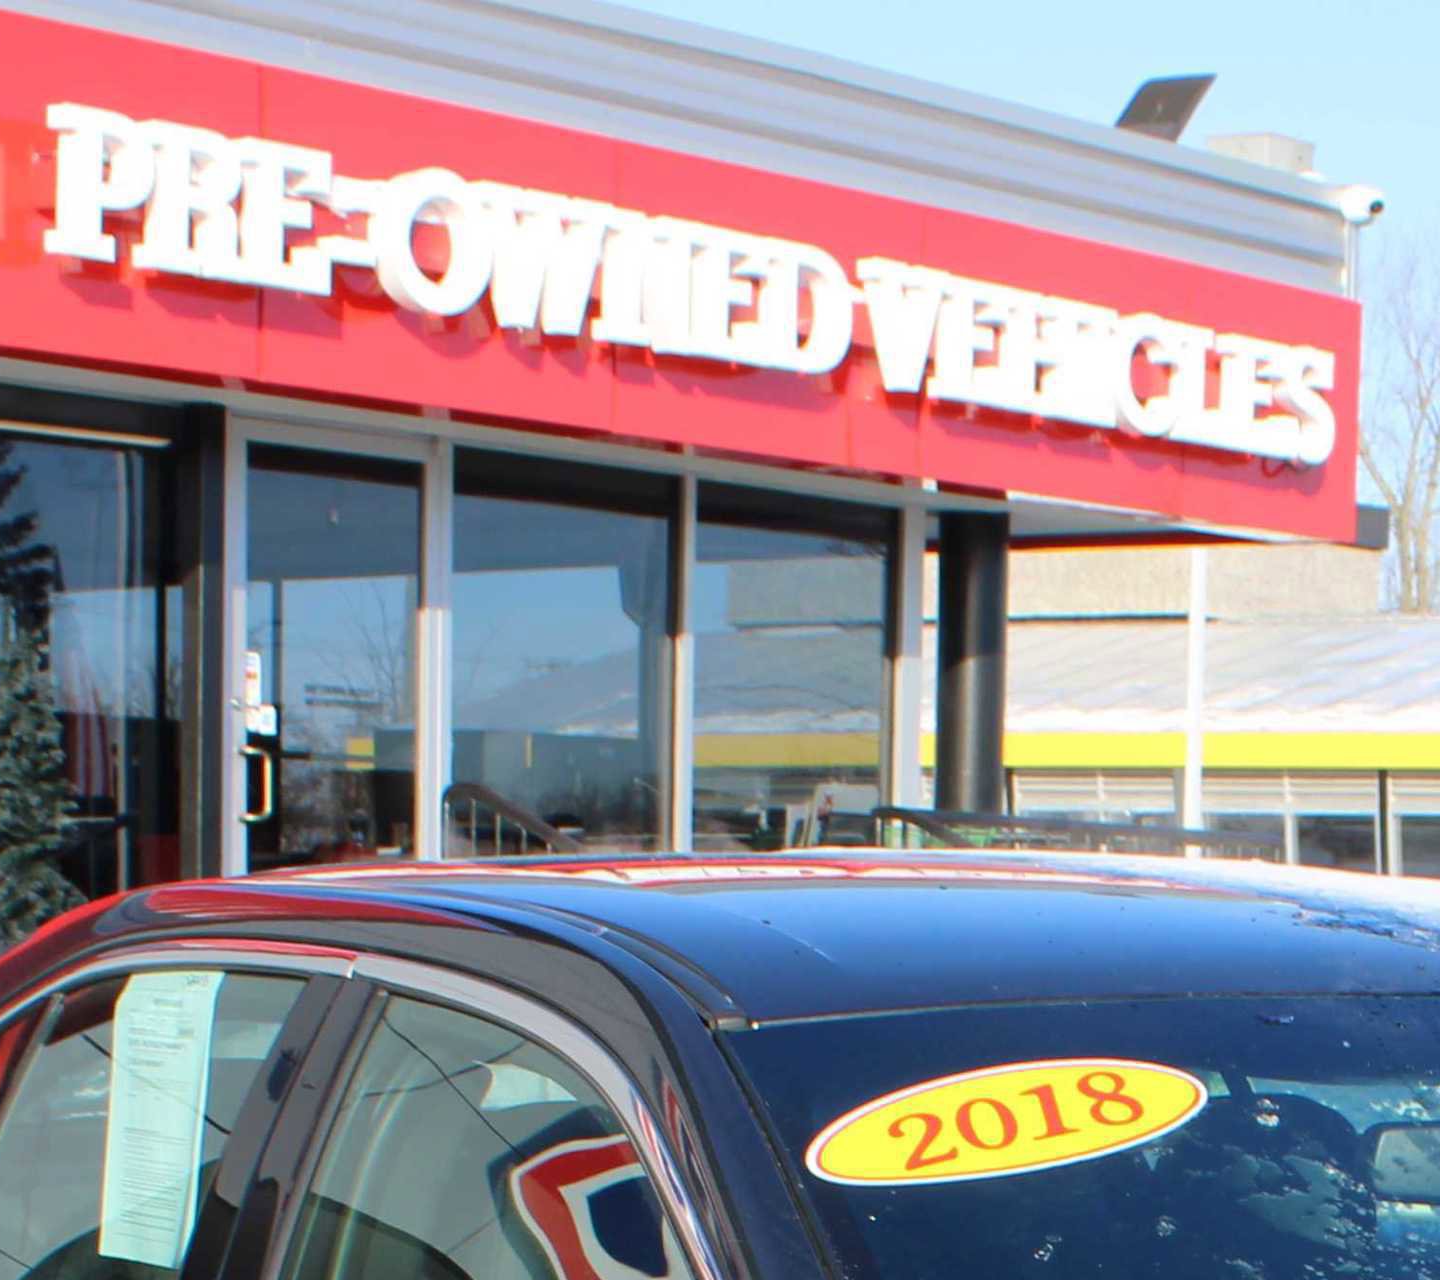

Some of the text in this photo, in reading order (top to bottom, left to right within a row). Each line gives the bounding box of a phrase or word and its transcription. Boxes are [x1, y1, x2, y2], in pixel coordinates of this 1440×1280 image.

[43, 101, 1337, 466] PRE-OWNED VEHICLES
[887, 1070, 1145, 1172] 2018
